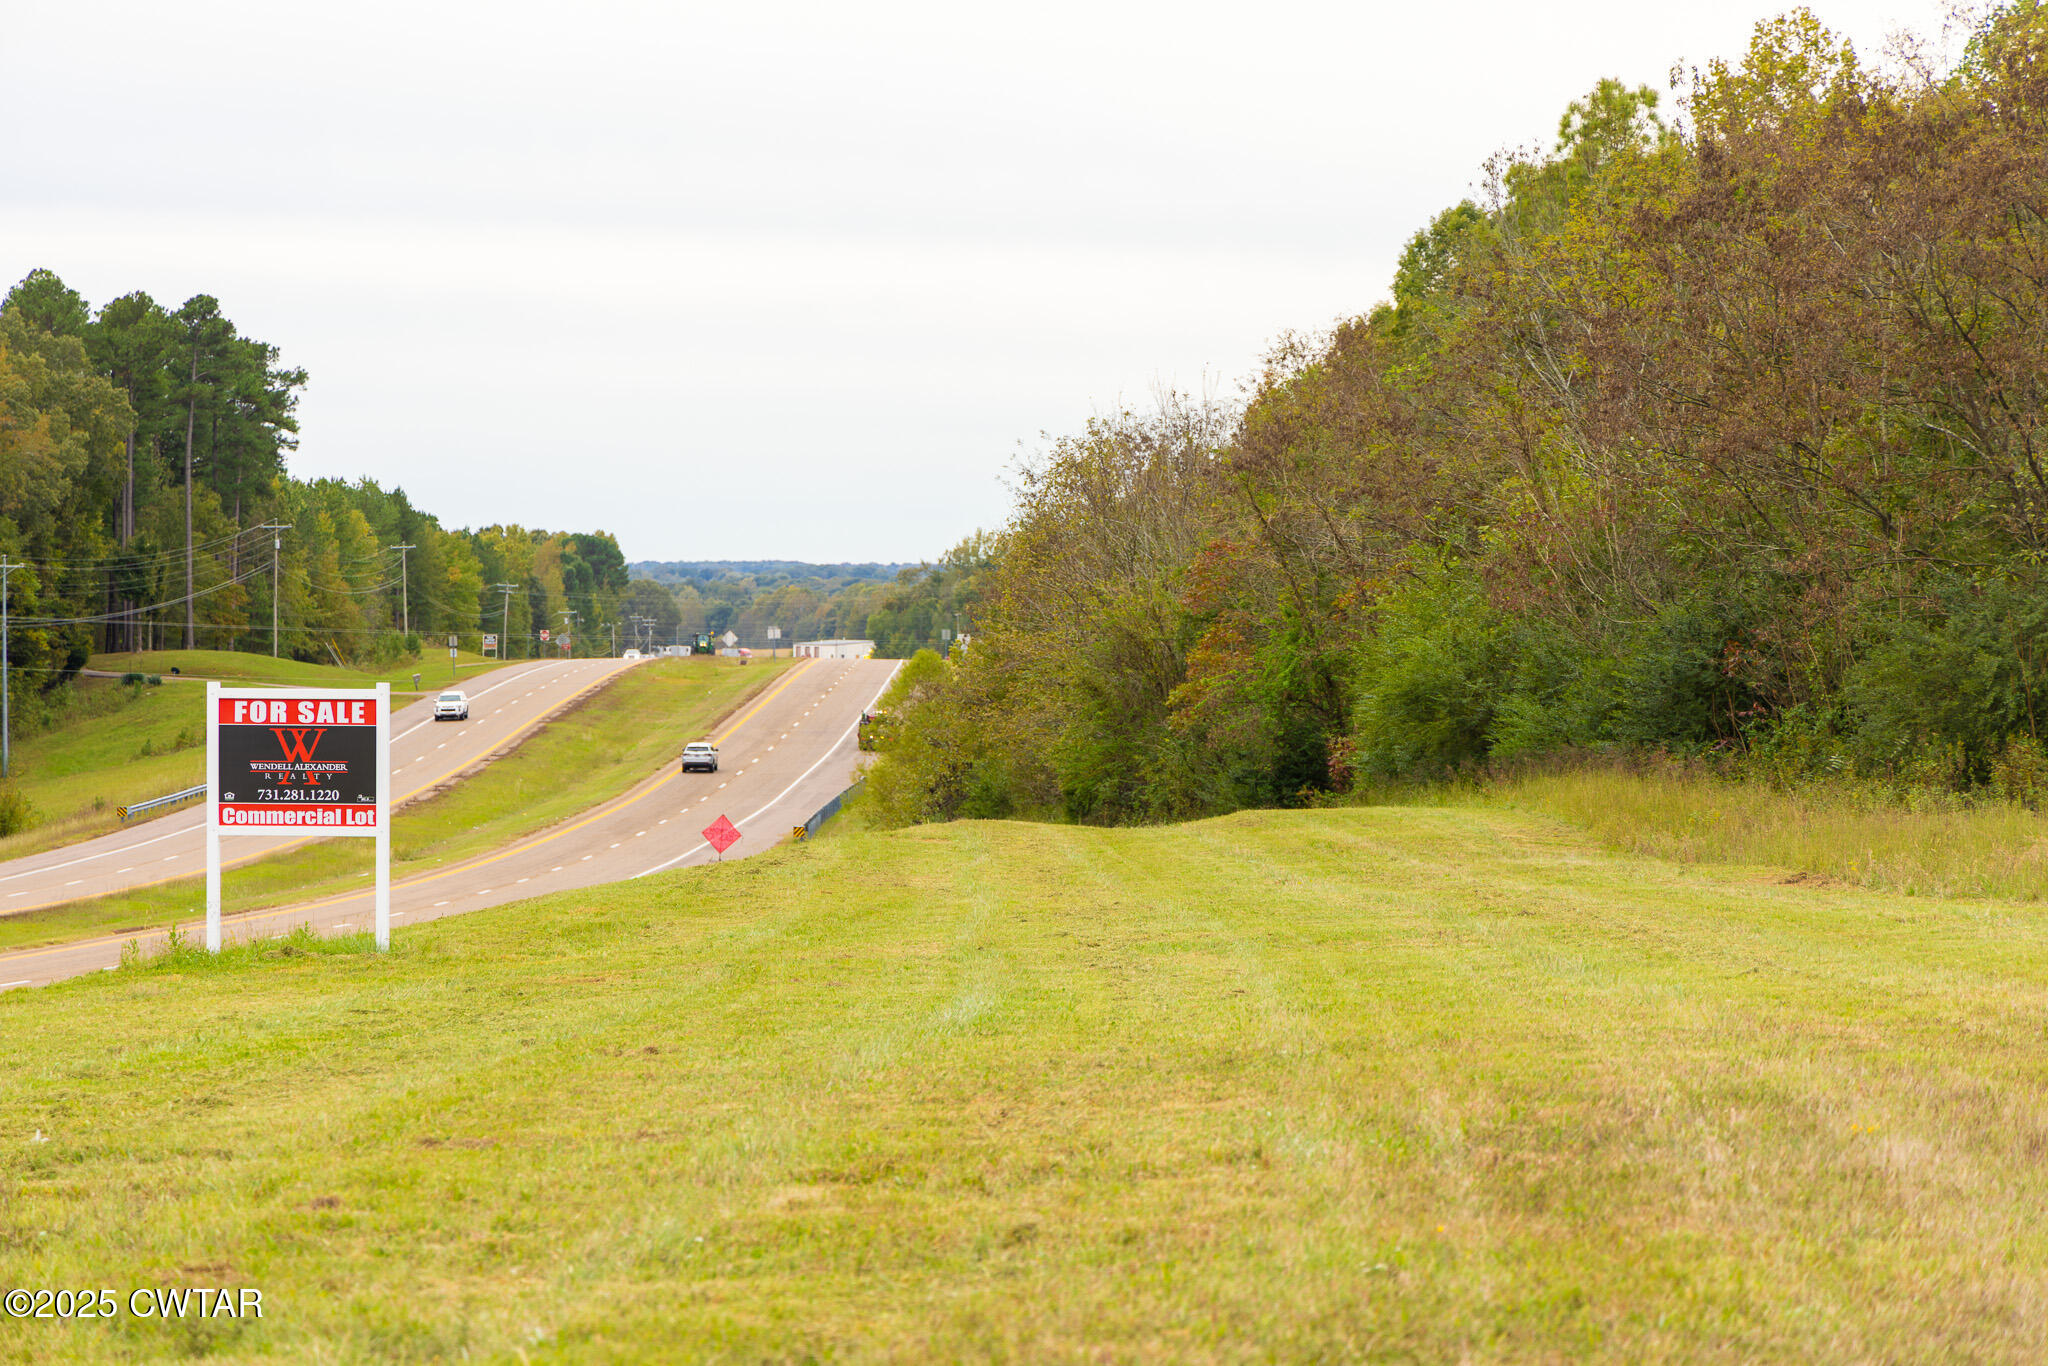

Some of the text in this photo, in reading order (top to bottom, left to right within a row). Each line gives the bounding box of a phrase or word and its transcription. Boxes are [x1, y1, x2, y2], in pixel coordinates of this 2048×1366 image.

[234, 700, 365, 724] FOR SALE
[250, 763, 348, 771] WENDELL ALEXANDER
[264, 772, 333, 780] REALTY
[257, 789, 340, 801] 731.281.1220
[222, 807, 375, 825] Commercial Lot
